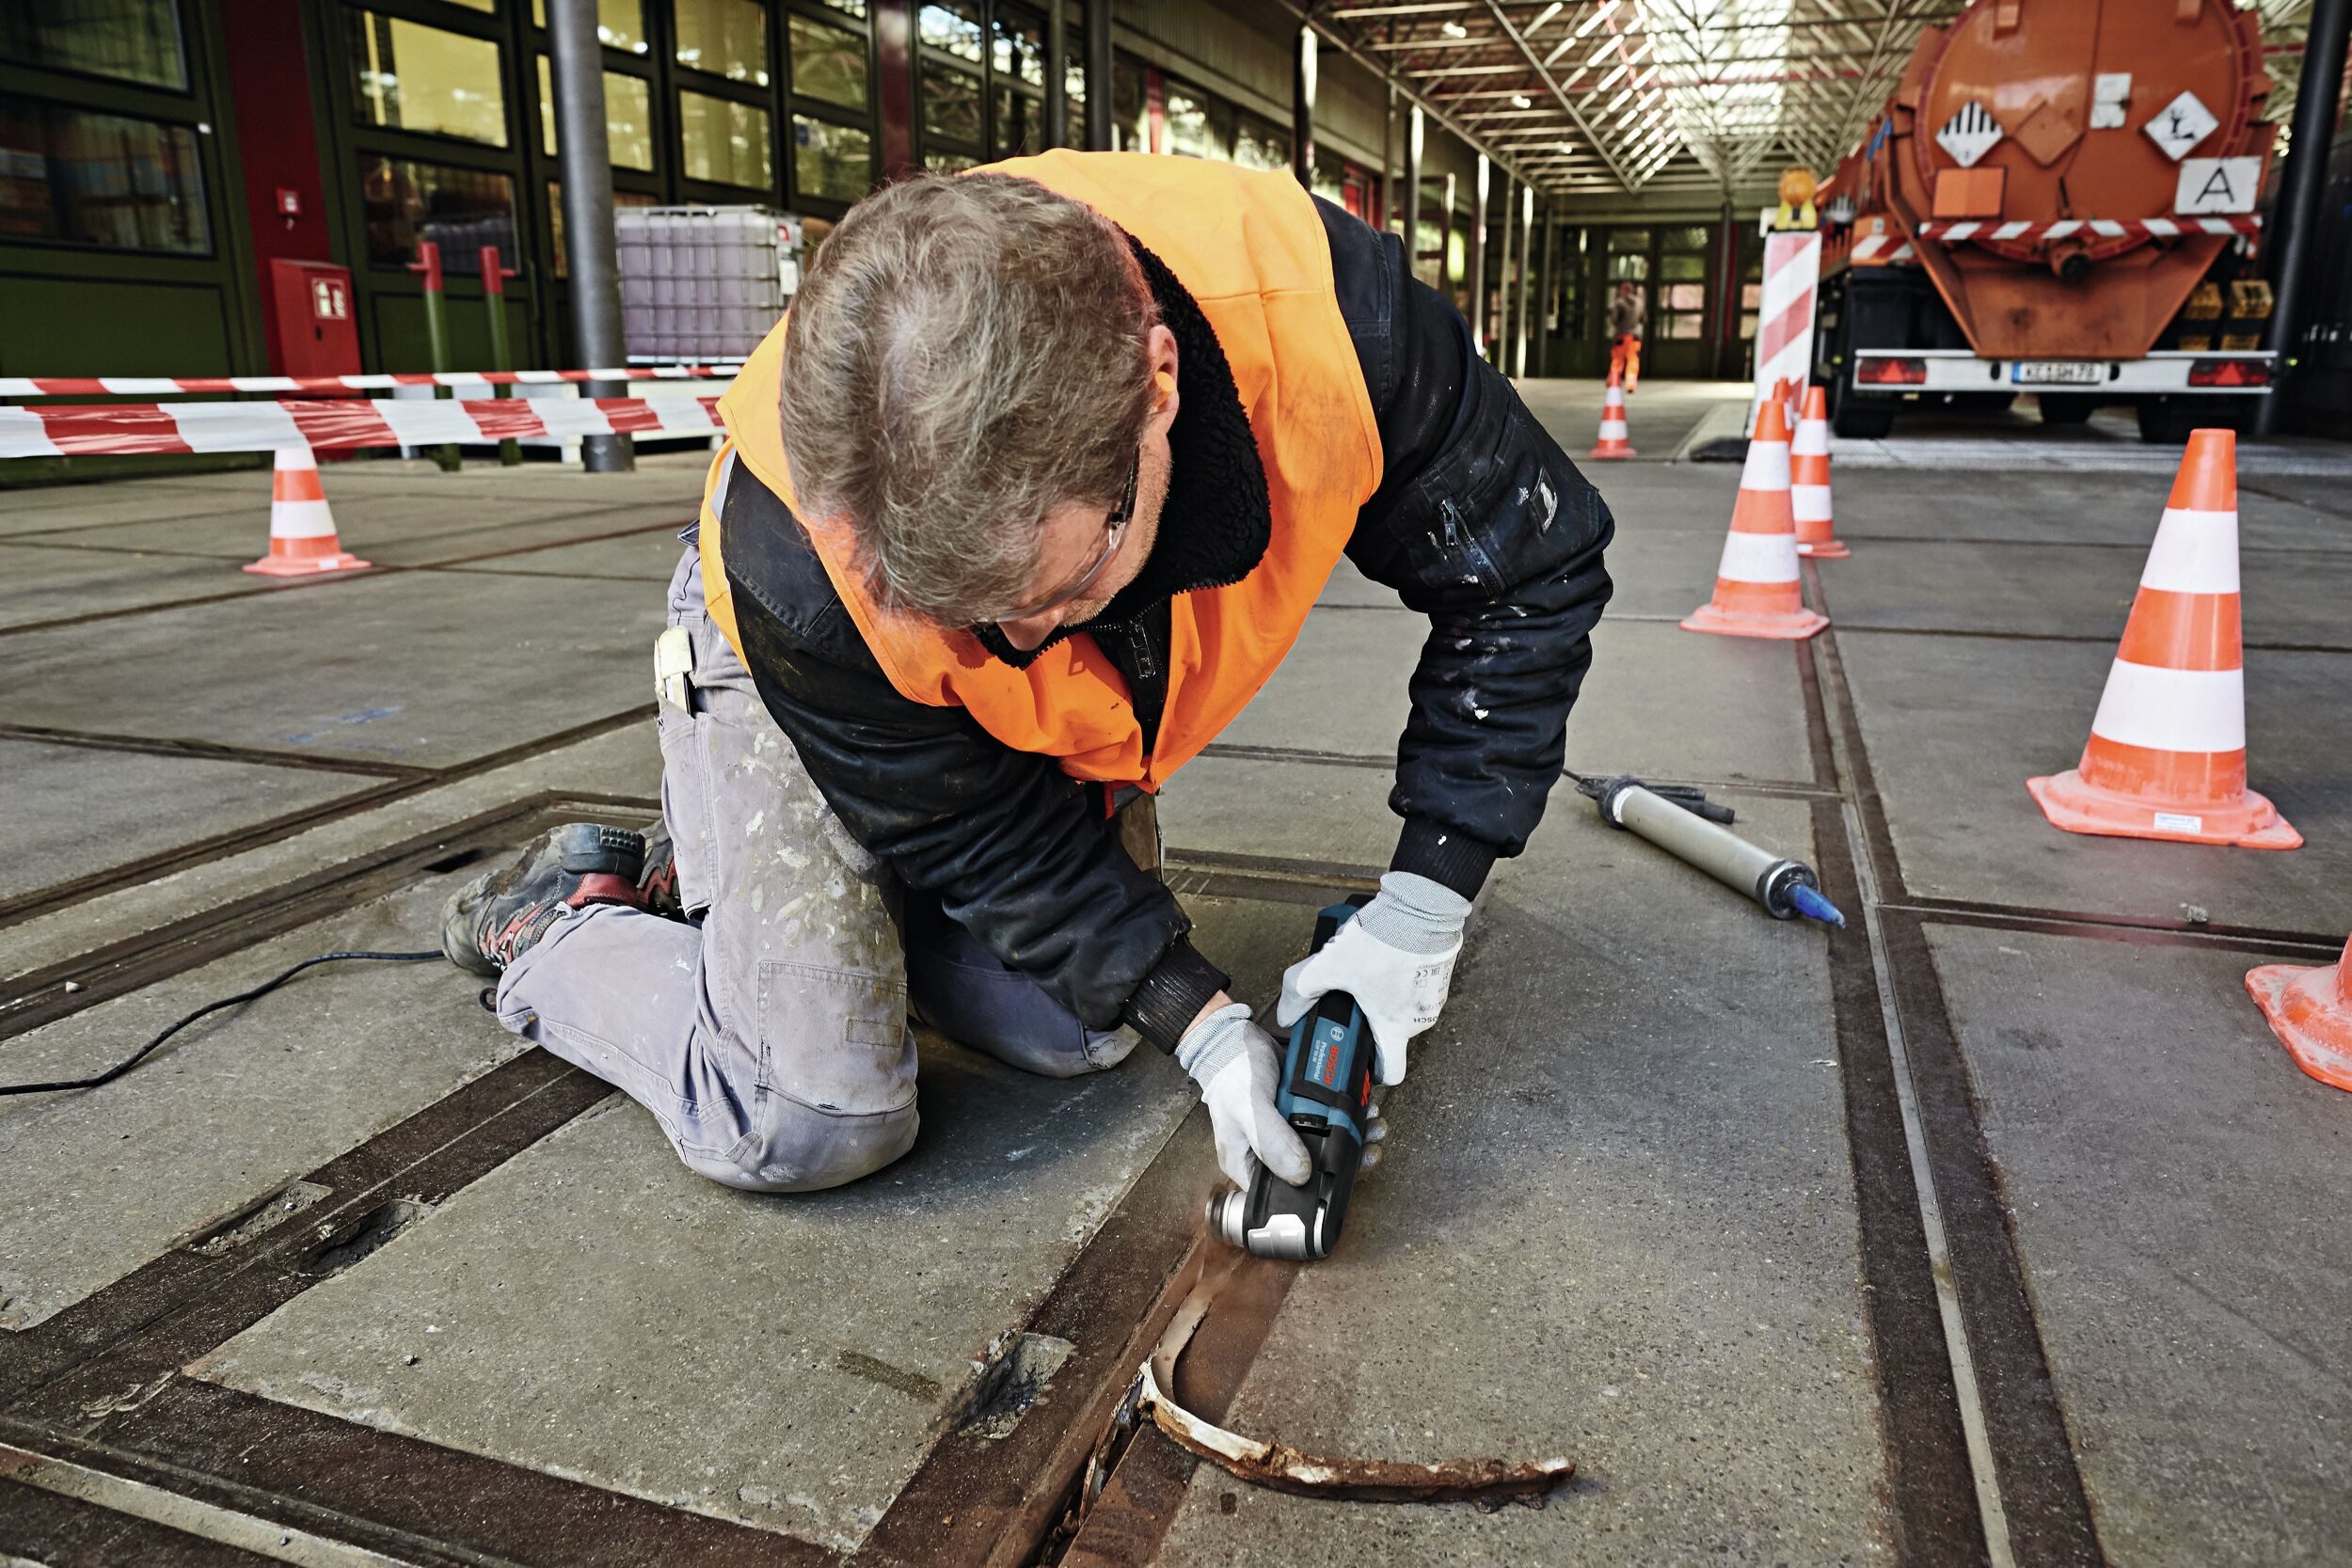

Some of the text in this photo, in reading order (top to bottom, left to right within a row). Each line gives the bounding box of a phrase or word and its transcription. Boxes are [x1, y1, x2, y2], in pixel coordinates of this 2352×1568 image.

[2195, 166, 2234, 204] A
[1313, 1041, 1327, 1081] Professional
[1324, 1044, 1339, 1085] BOSCH
